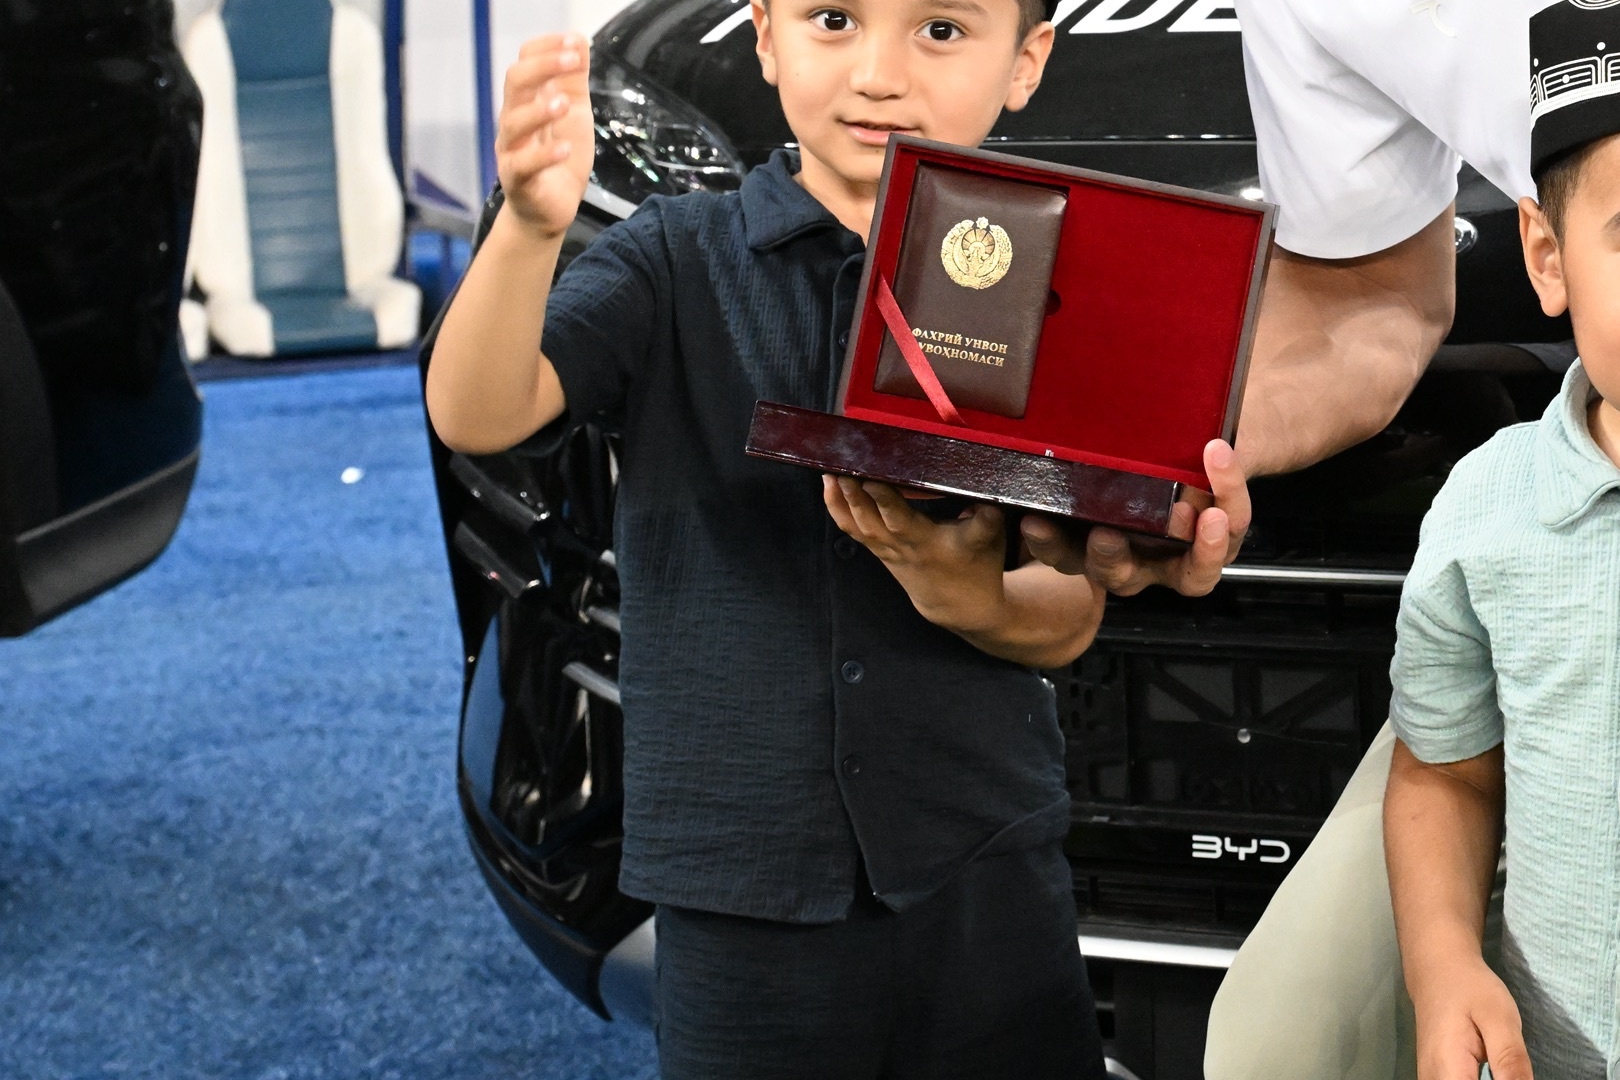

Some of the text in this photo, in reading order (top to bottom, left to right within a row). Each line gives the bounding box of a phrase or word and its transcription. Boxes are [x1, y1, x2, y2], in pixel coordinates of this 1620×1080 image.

[911, 328, 1008, 354] ФАХРИЙ УНВОН
[918, 341, 1005, 367] УВОҲНОМАСИ
[1192, 835, 1290, 863] BYD
